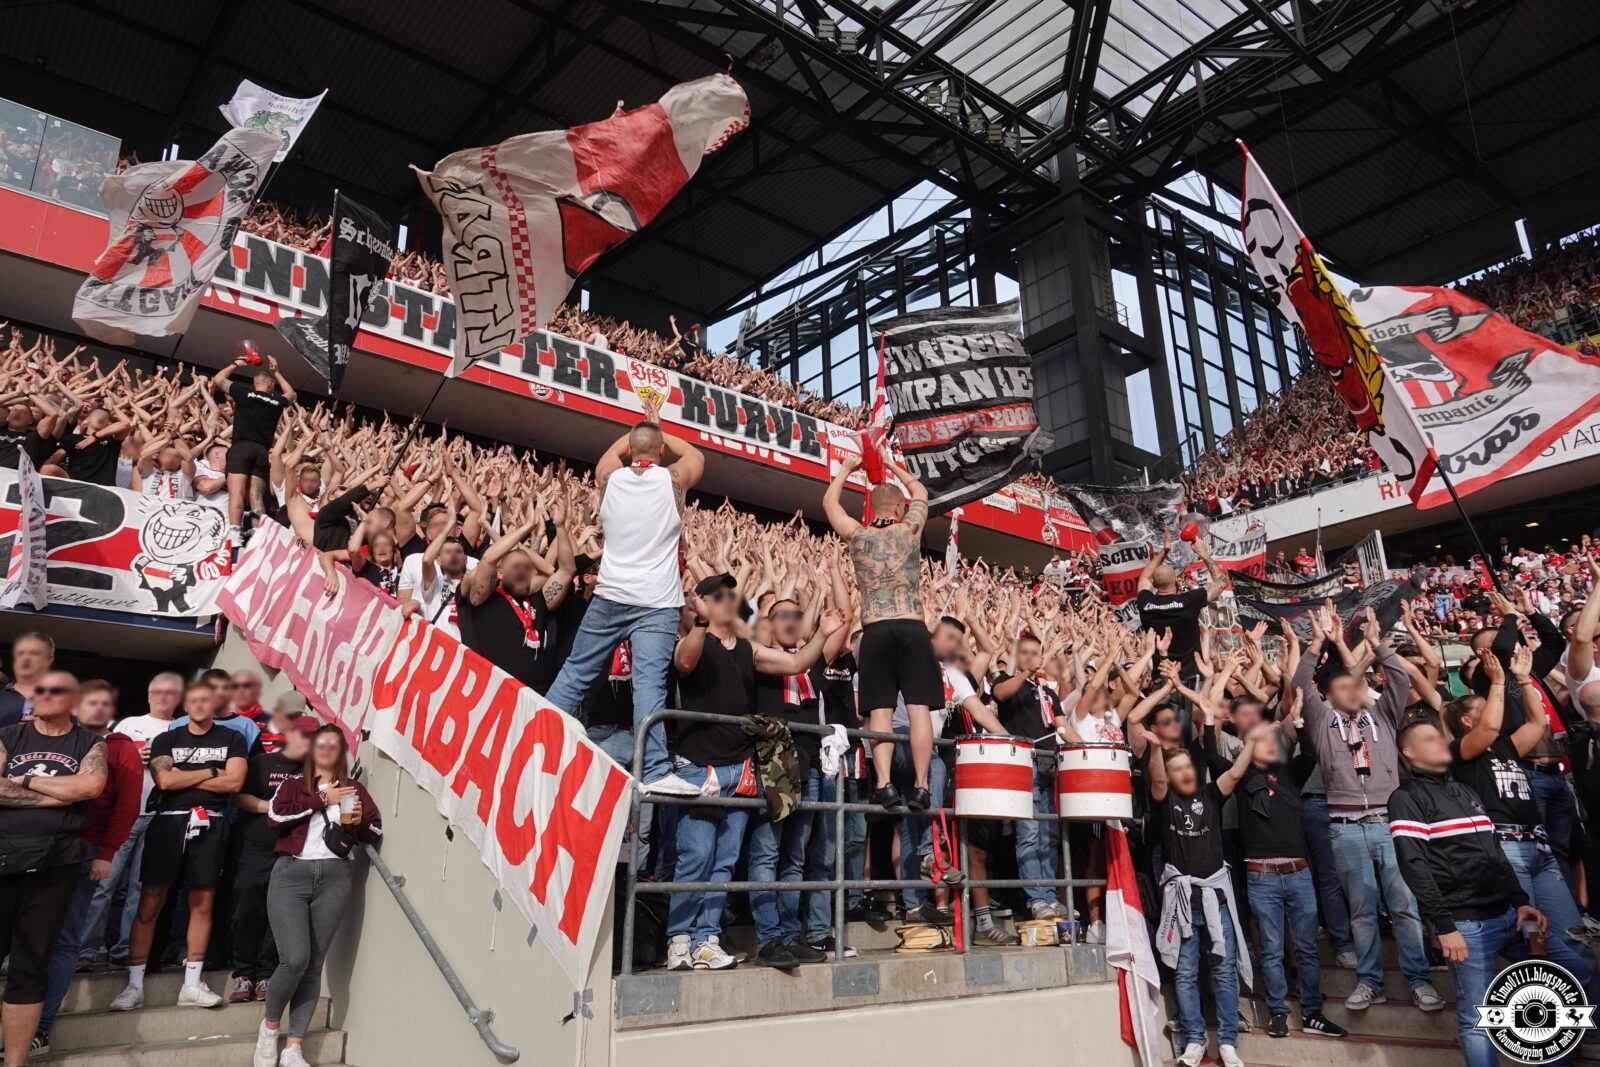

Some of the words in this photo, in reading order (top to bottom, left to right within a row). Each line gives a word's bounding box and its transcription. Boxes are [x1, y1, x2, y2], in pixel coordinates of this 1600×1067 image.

[886, 366, 1034, 416] OMPANIE
[1417, 393, 1497, 424] mpanie
[680, 377, 824, 459] KURVE
[1100, 541, 1151, 567] SCHW
[371, 613, 634, 947] URBACH
